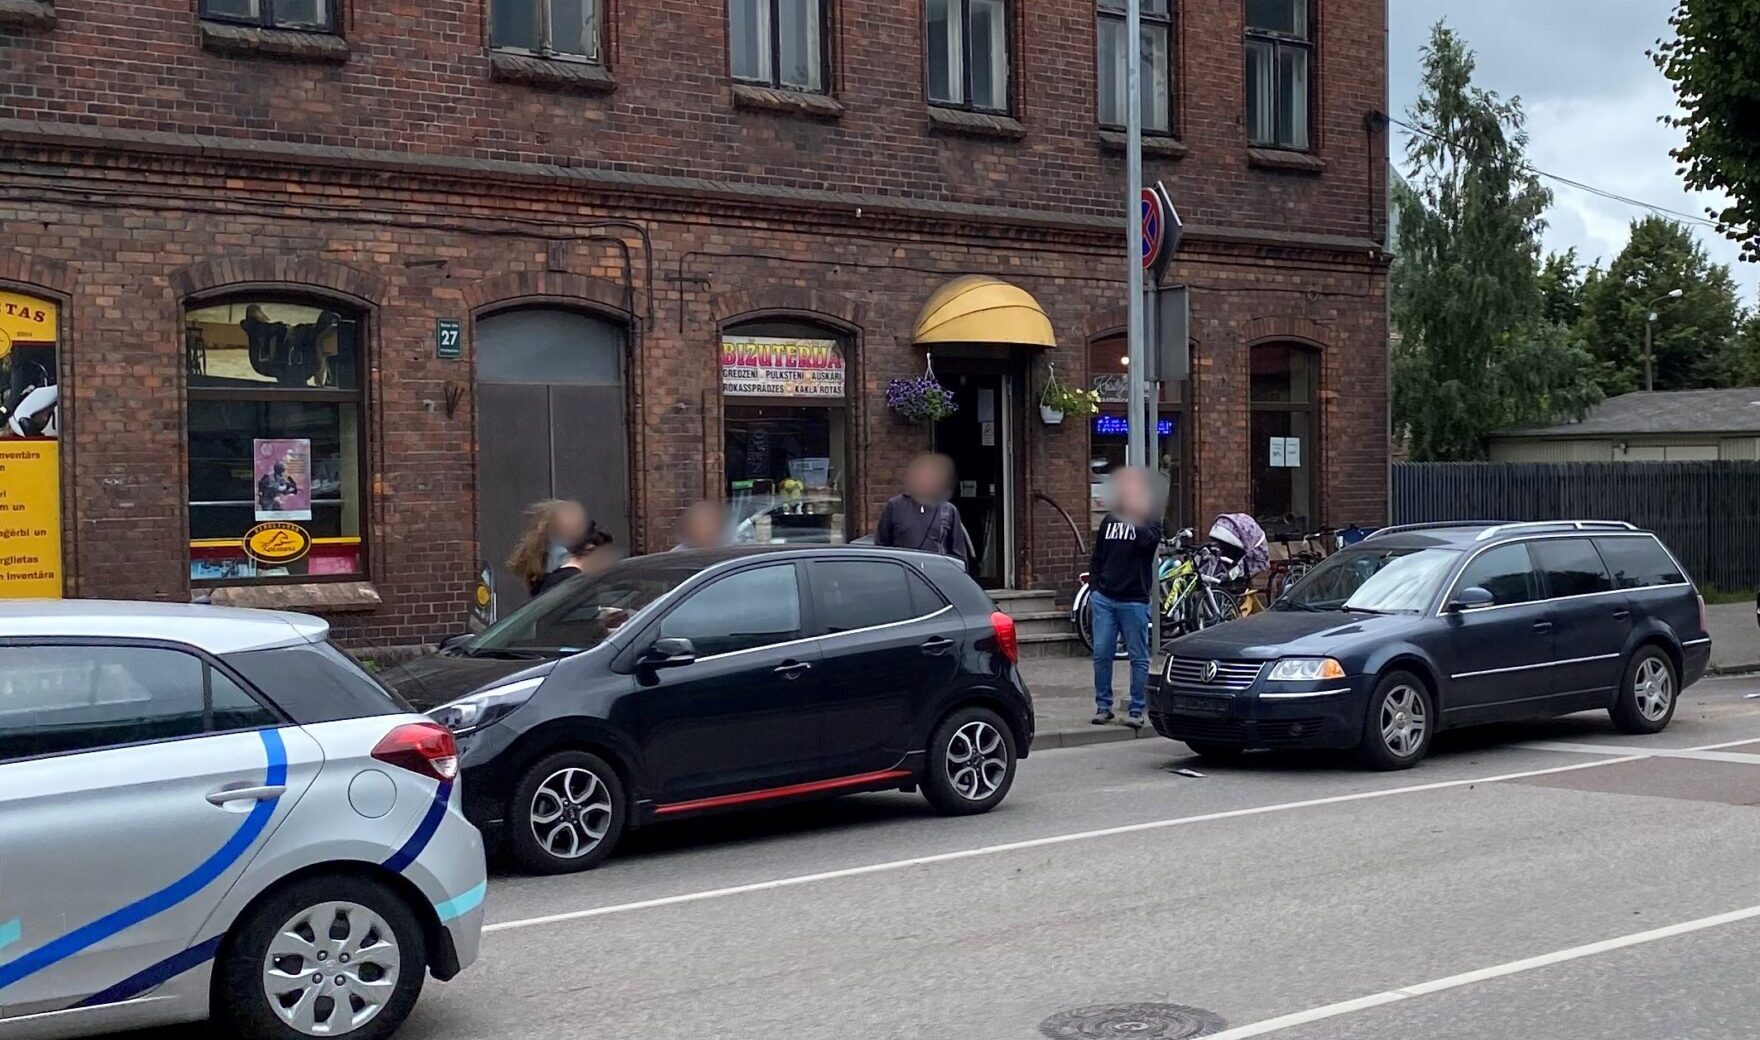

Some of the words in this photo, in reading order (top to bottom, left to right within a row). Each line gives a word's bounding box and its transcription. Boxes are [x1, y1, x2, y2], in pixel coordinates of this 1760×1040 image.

[0, 302, 46, 323] TAS
[441, 330, 458, 346] 27
[795, 385, 818, 394] KAKLA
